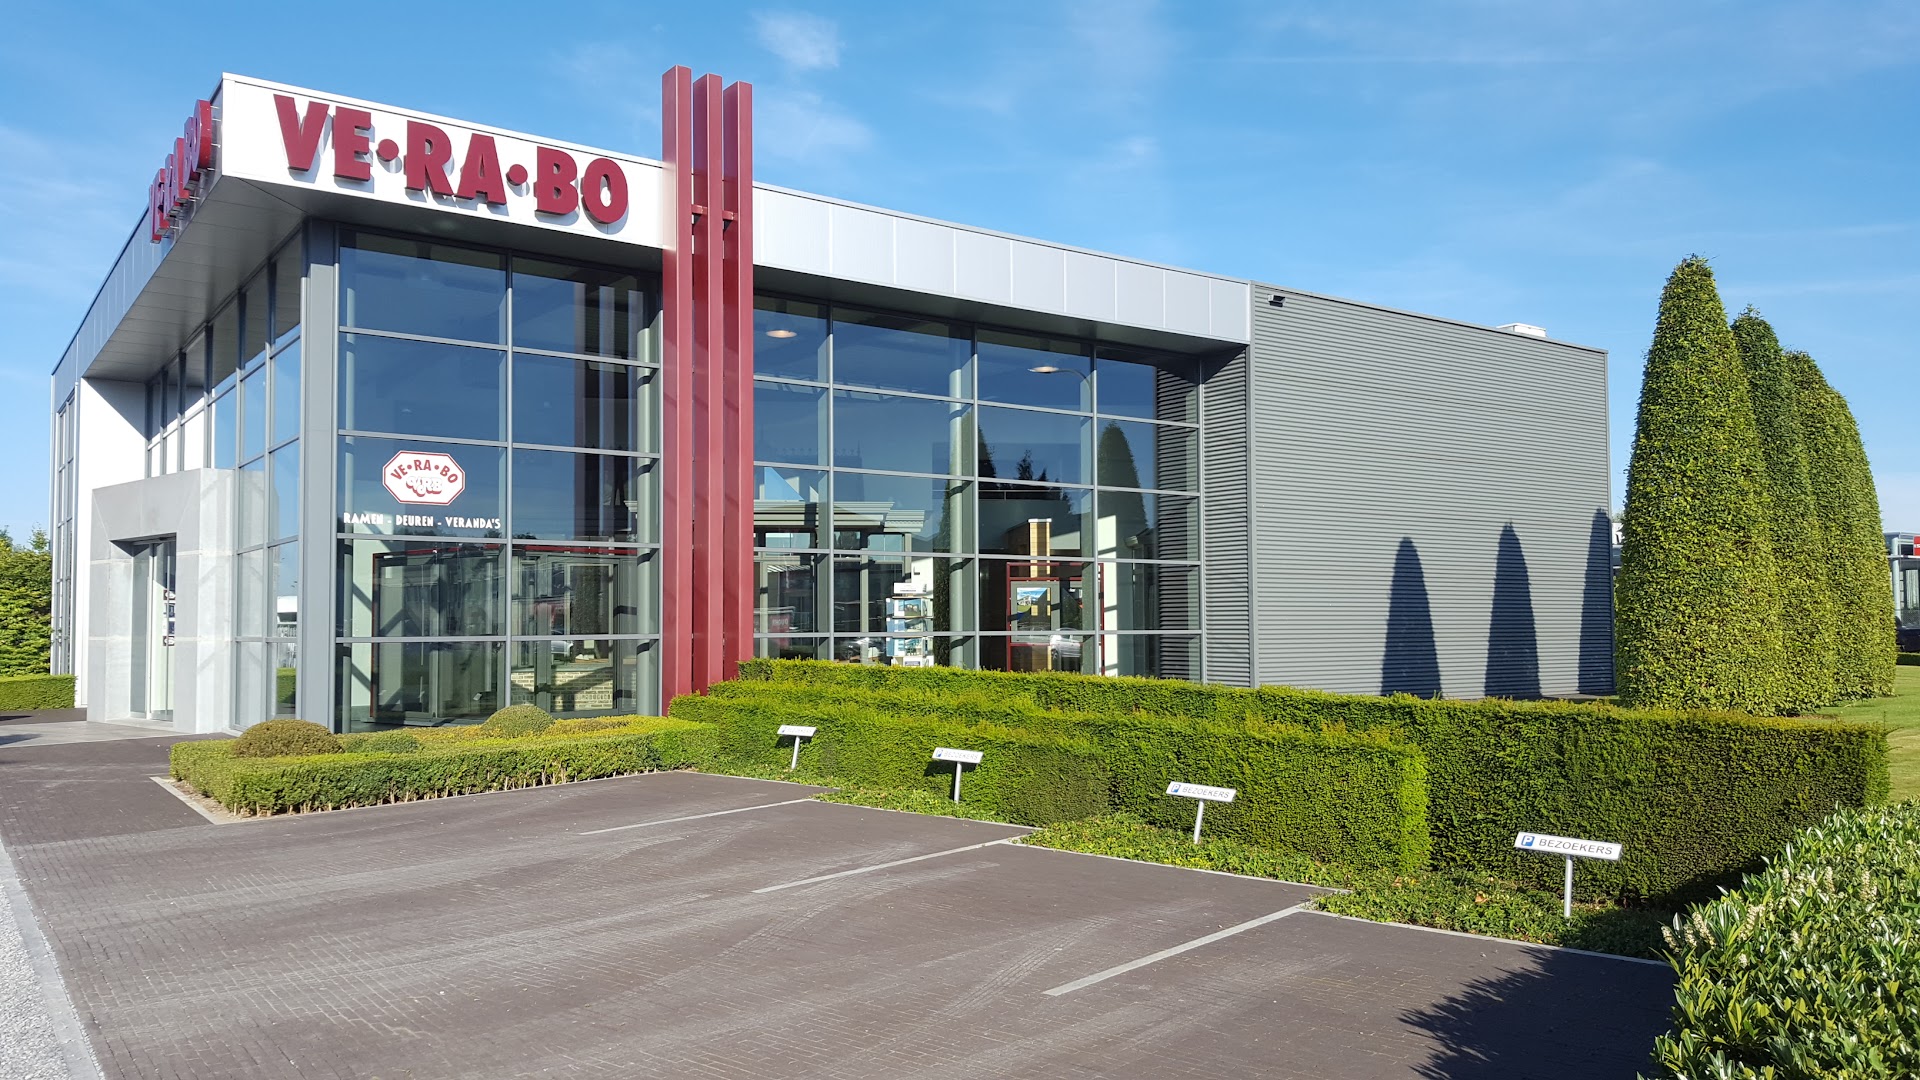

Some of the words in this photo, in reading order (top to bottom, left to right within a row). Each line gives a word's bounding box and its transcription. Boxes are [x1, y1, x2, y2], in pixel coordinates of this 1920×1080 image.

[343, 512, 384, 525] RAMEN
[395, 515, 434, 527] DEUREN
[445, 516, 501, 530] VERANDA'S
[1182, 786, 1230, 799] BEZOEKERS
[1539, 838, 1613, 855] BEZOEKERS
